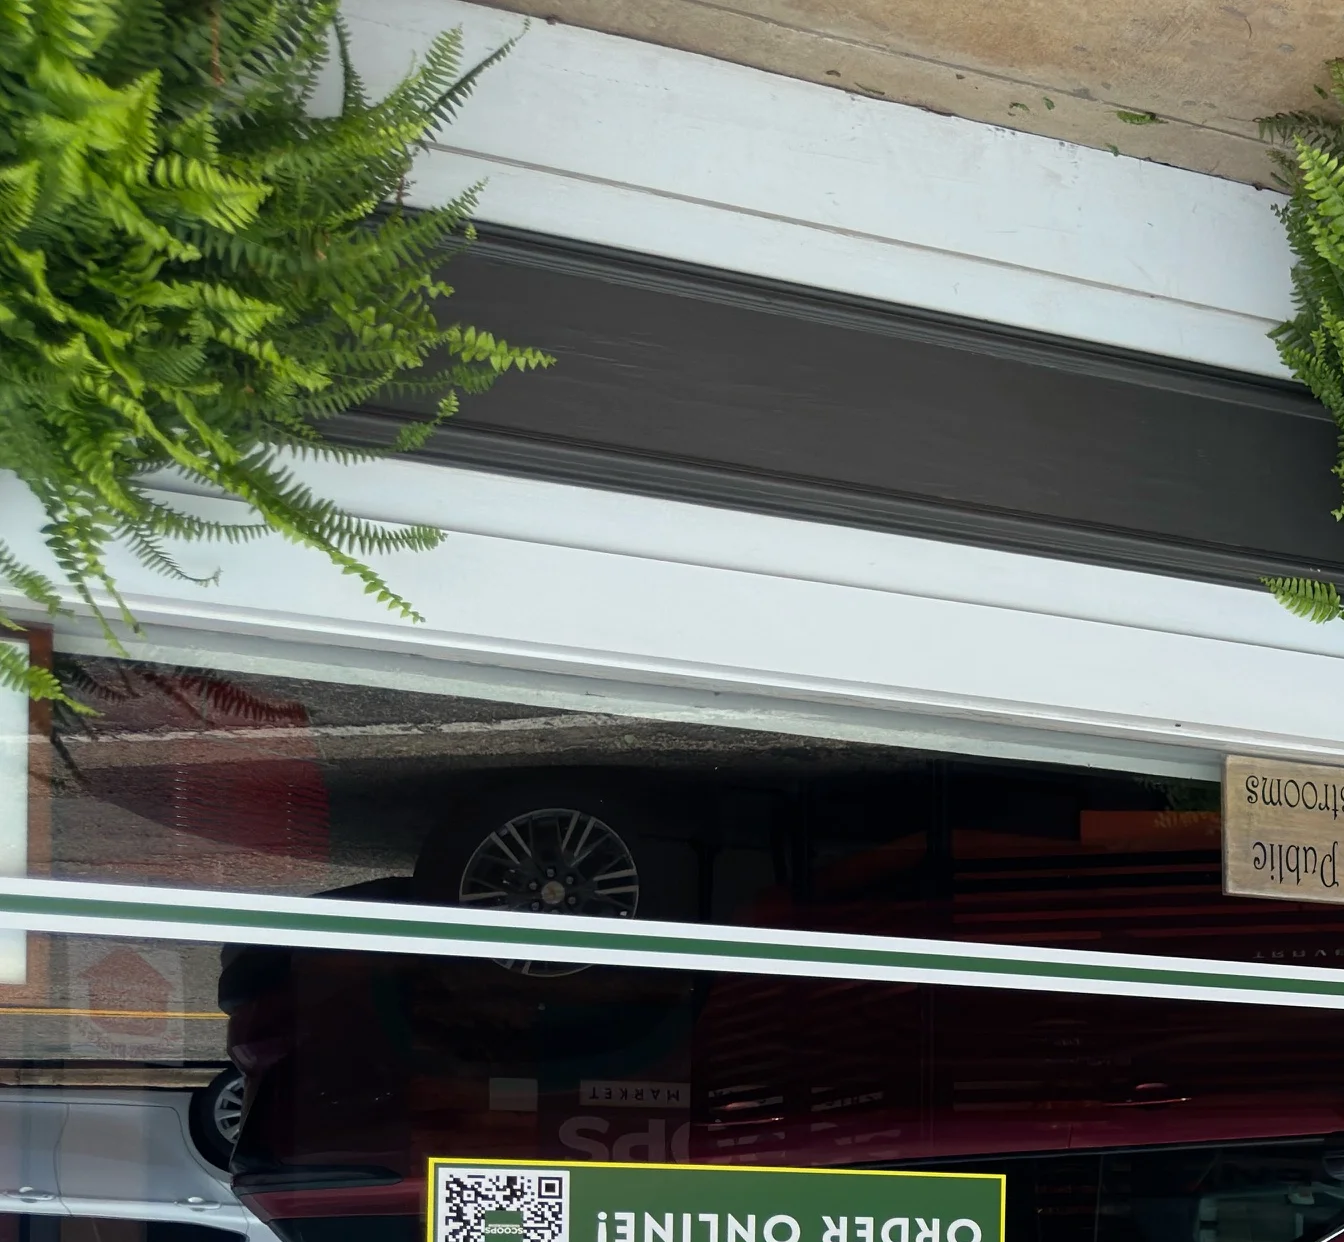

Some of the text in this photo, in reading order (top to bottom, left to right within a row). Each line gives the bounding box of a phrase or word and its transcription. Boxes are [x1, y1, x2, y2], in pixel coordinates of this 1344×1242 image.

[1252, 840, 1339, 888] Public
[587, 1085, 680, 1102] MARKET
[484, 1226, 524, 1235] SCOOPS
